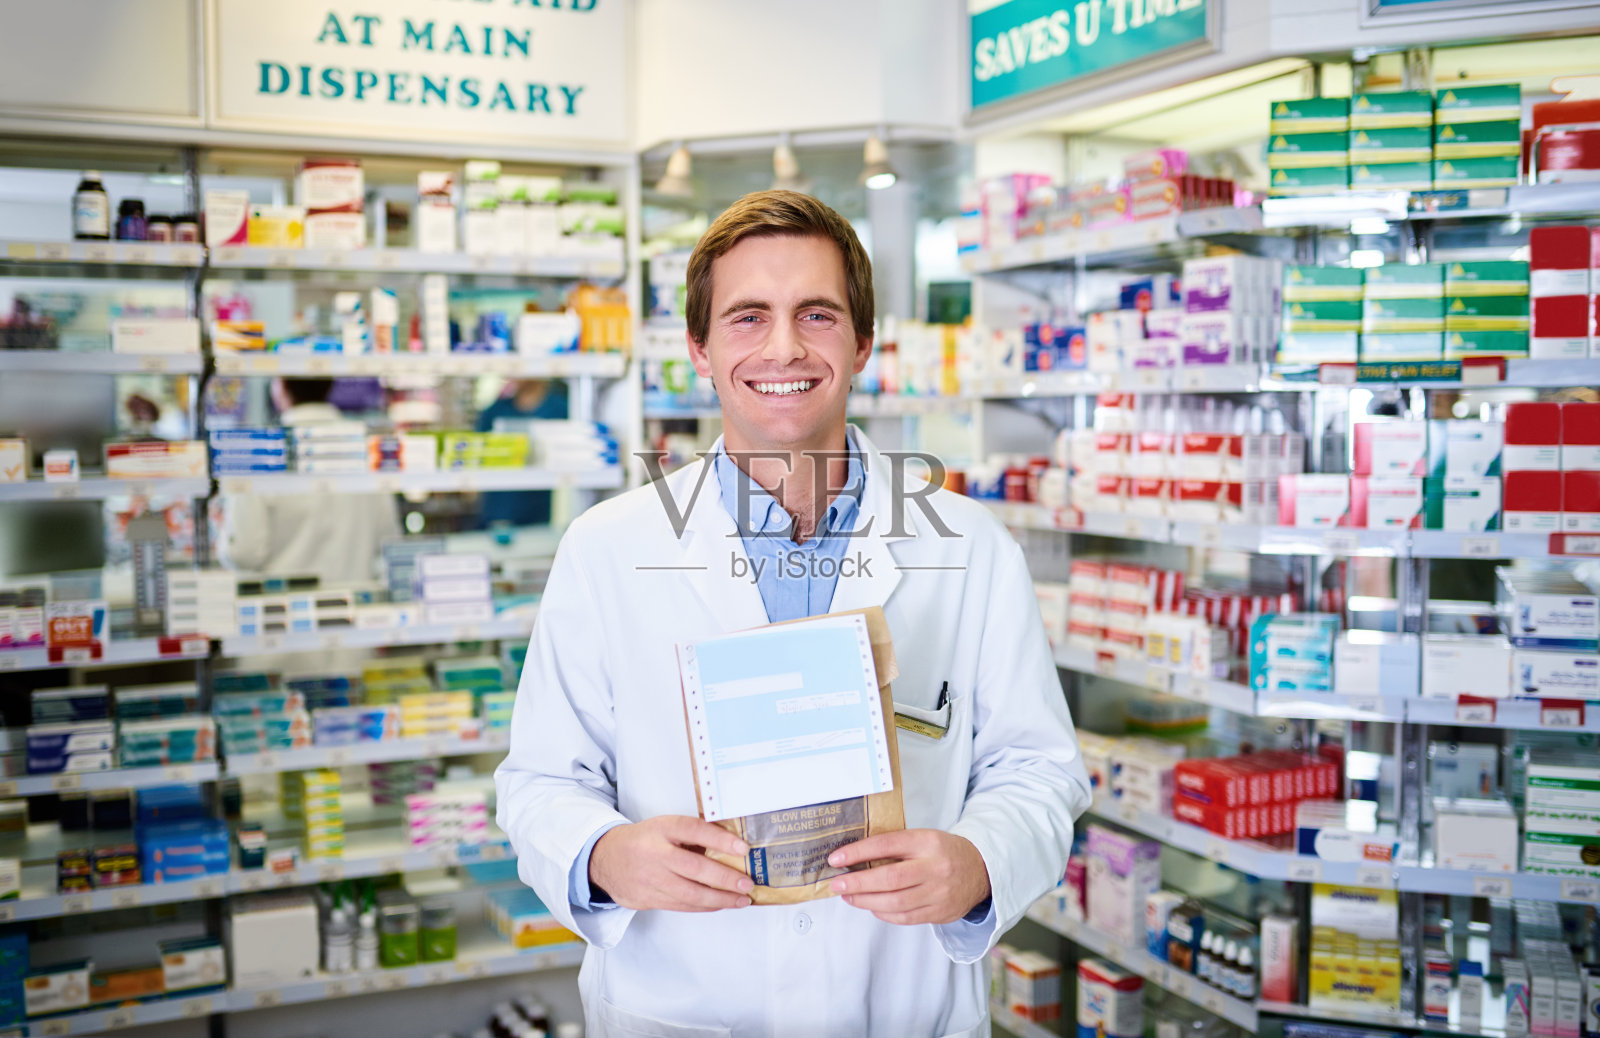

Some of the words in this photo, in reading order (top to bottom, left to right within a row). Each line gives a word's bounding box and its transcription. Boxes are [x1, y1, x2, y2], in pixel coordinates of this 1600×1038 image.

[317, 12, 381, 46] AT
[402, 19, 533, 57] MAIN
[974, 10, 1070, 82] SAVES
[1074, 0, 1100, 46] U
[1106, 0, 1204, 35] TIM
[257, 61, 586, 116] DISPENSARY
[771, 812, 798, 824] SLOW
[801, 804, 842, 820] RELEASE
[779, 816, 836, 833] MAGNESIUM
